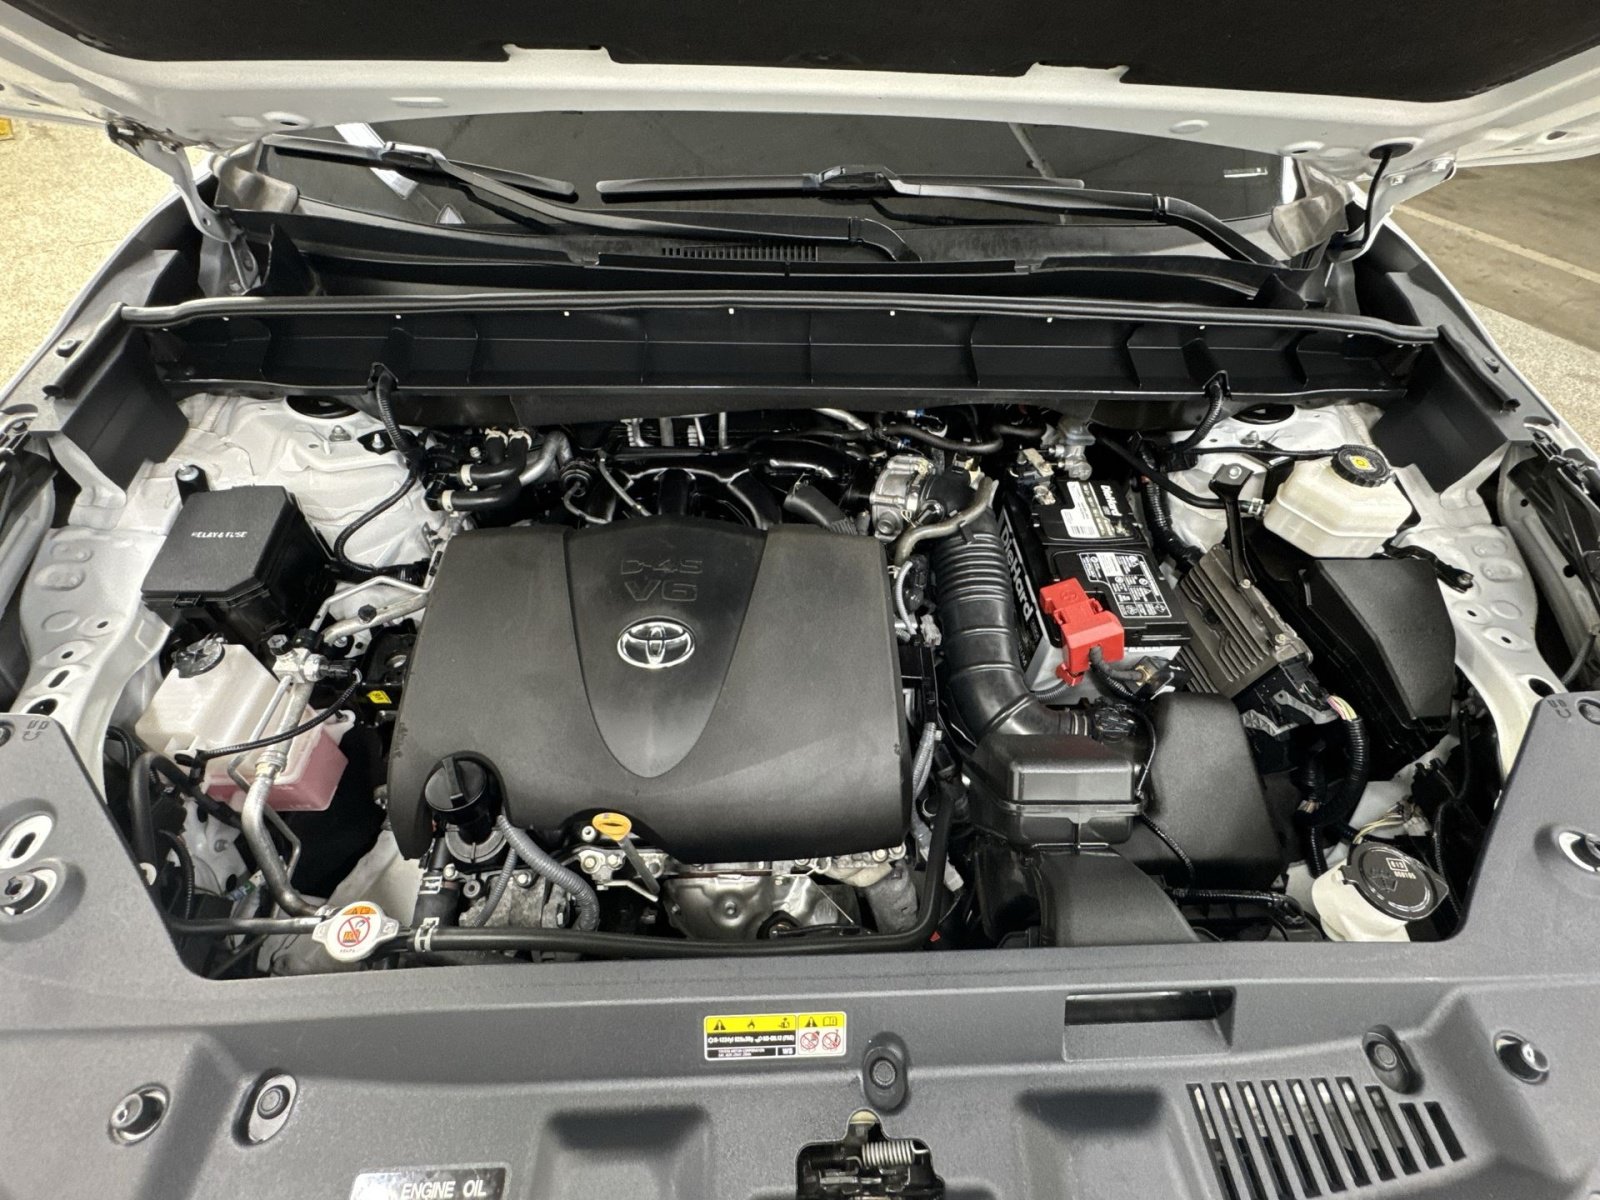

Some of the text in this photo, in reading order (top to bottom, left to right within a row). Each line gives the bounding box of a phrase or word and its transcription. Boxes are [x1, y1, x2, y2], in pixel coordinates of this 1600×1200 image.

[1000, 525, 1034, 623] DieHard
[624, 580, 697, 601] V6
[401, 1180, 487, 1199] ENGINE OIL
